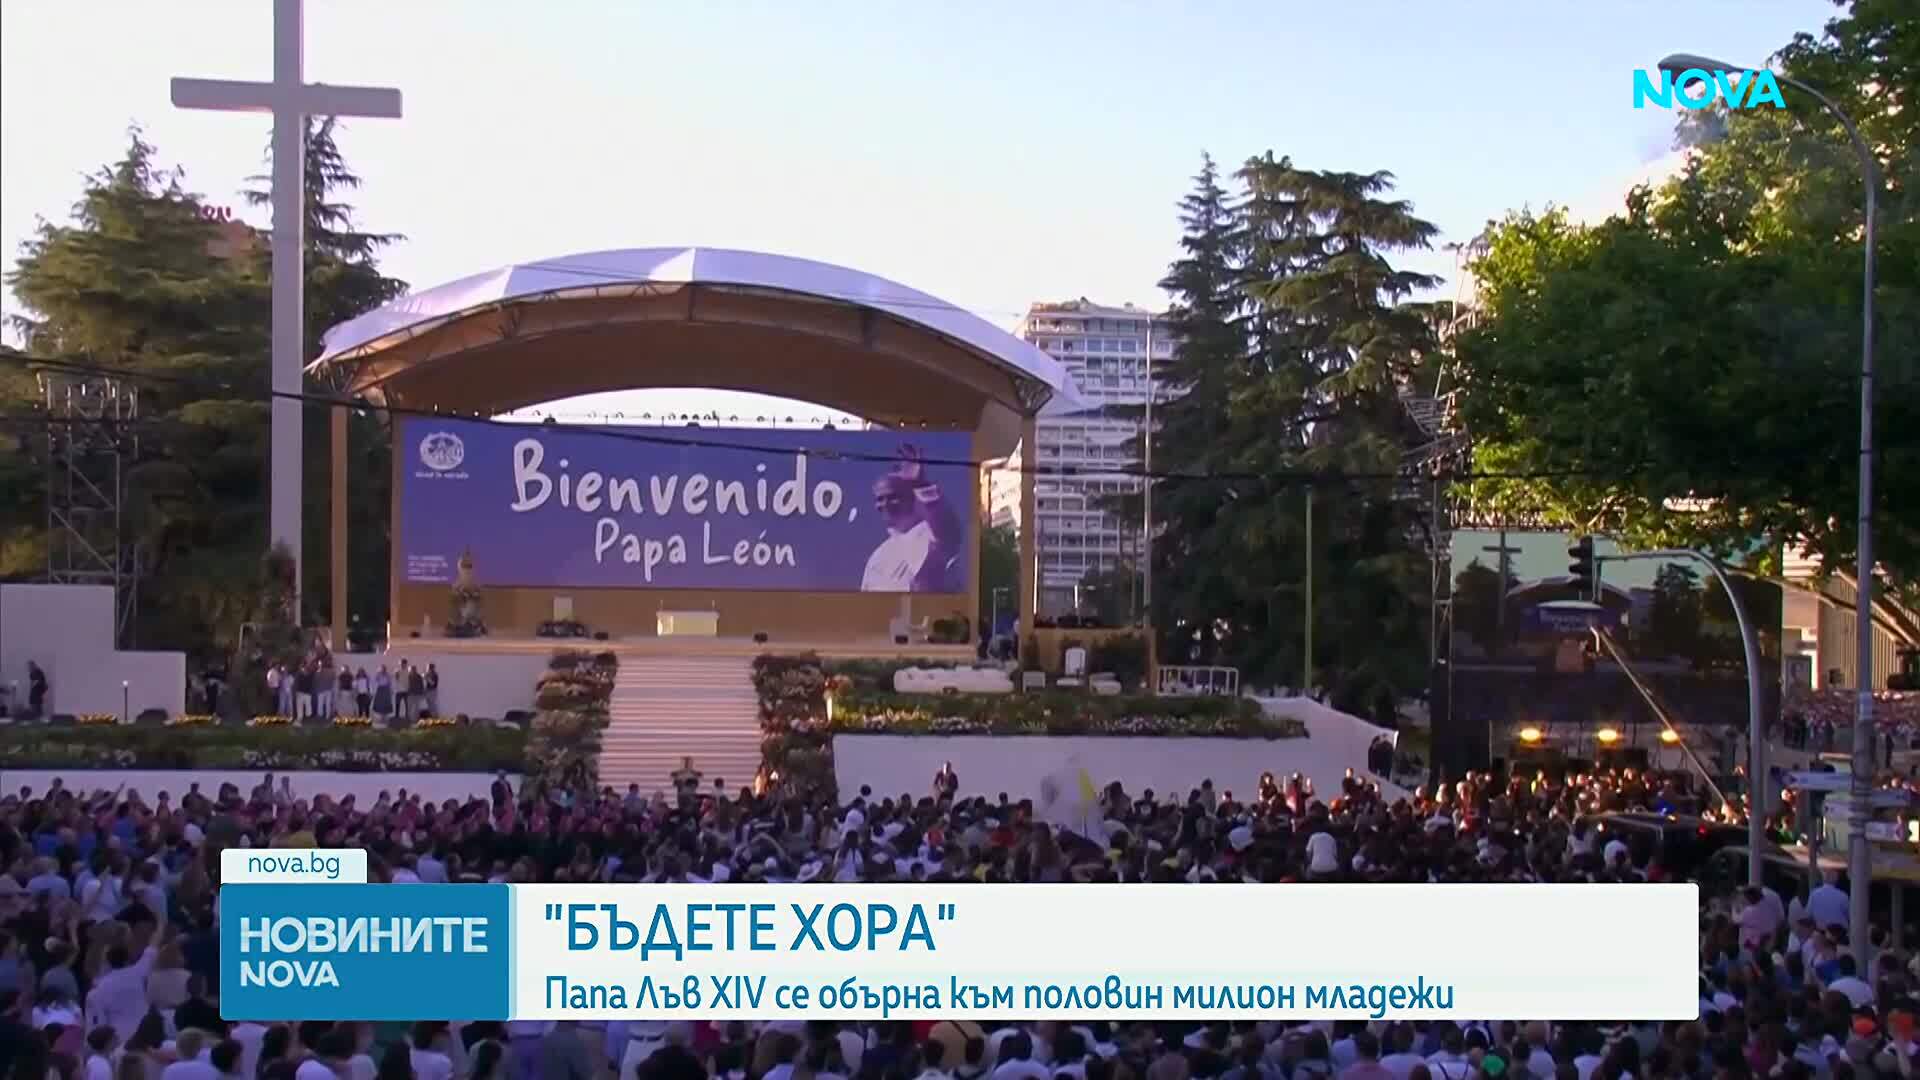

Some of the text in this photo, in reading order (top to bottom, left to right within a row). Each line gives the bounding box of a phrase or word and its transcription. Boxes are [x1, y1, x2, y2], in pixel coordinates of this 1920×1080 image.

[511, 438, 857, 522] Bienvenido,
[594, 517, 796, 582] Papa León
